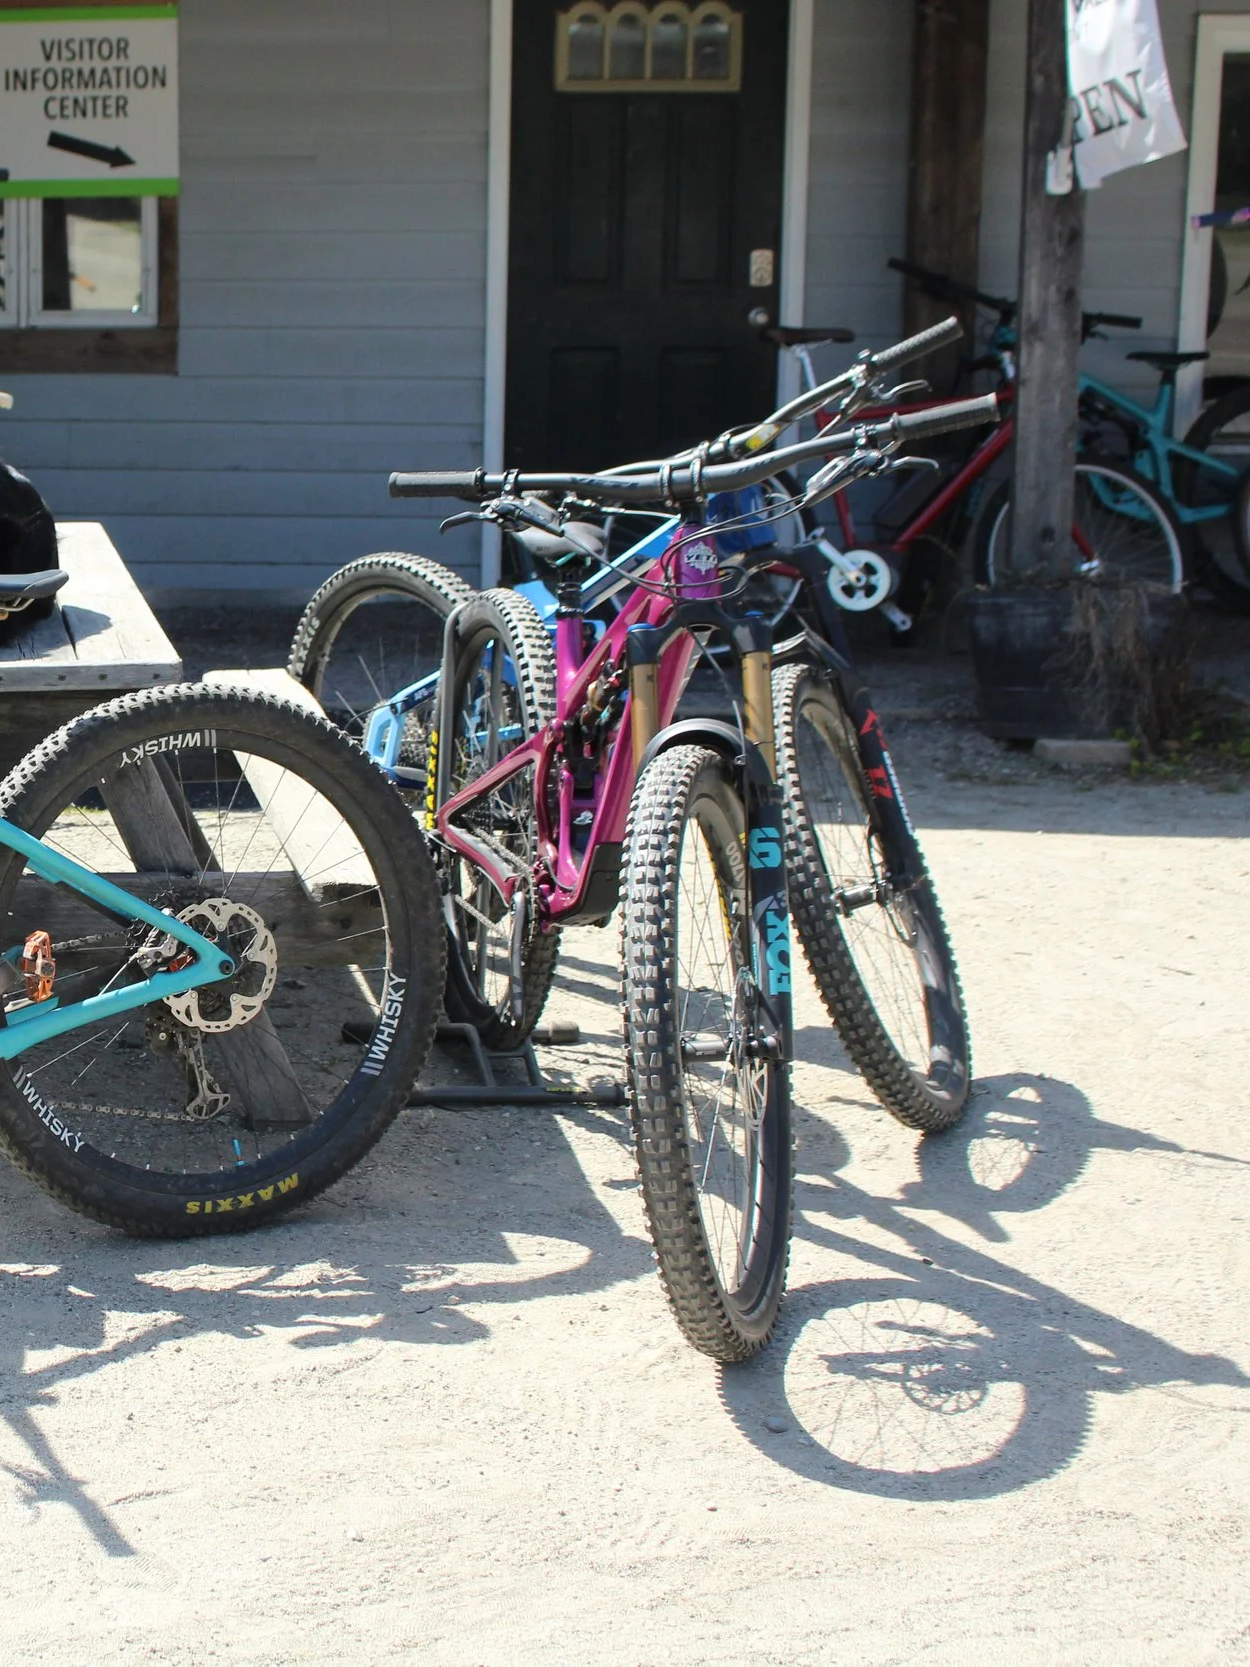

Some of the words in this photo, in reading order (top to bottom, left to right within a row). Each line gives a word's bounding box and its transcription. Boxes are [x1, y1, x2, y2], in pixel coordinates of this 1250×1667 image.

[40, 37, 130, 62] VISITOR
[4, 65, 168, 91] INFORMATION
[43, 95, 129, 120] CENTER
[1068, 69, 1147, 144] PEN
[120, 732, 201, 768] WHISKY
[766, 911, 792, 996] FOX
[368, 972, 407, 1060] WHISKY
[22, 1080, 85, 1153] WHISKY
[185, 1172, 299, 1214] MAXXIS
